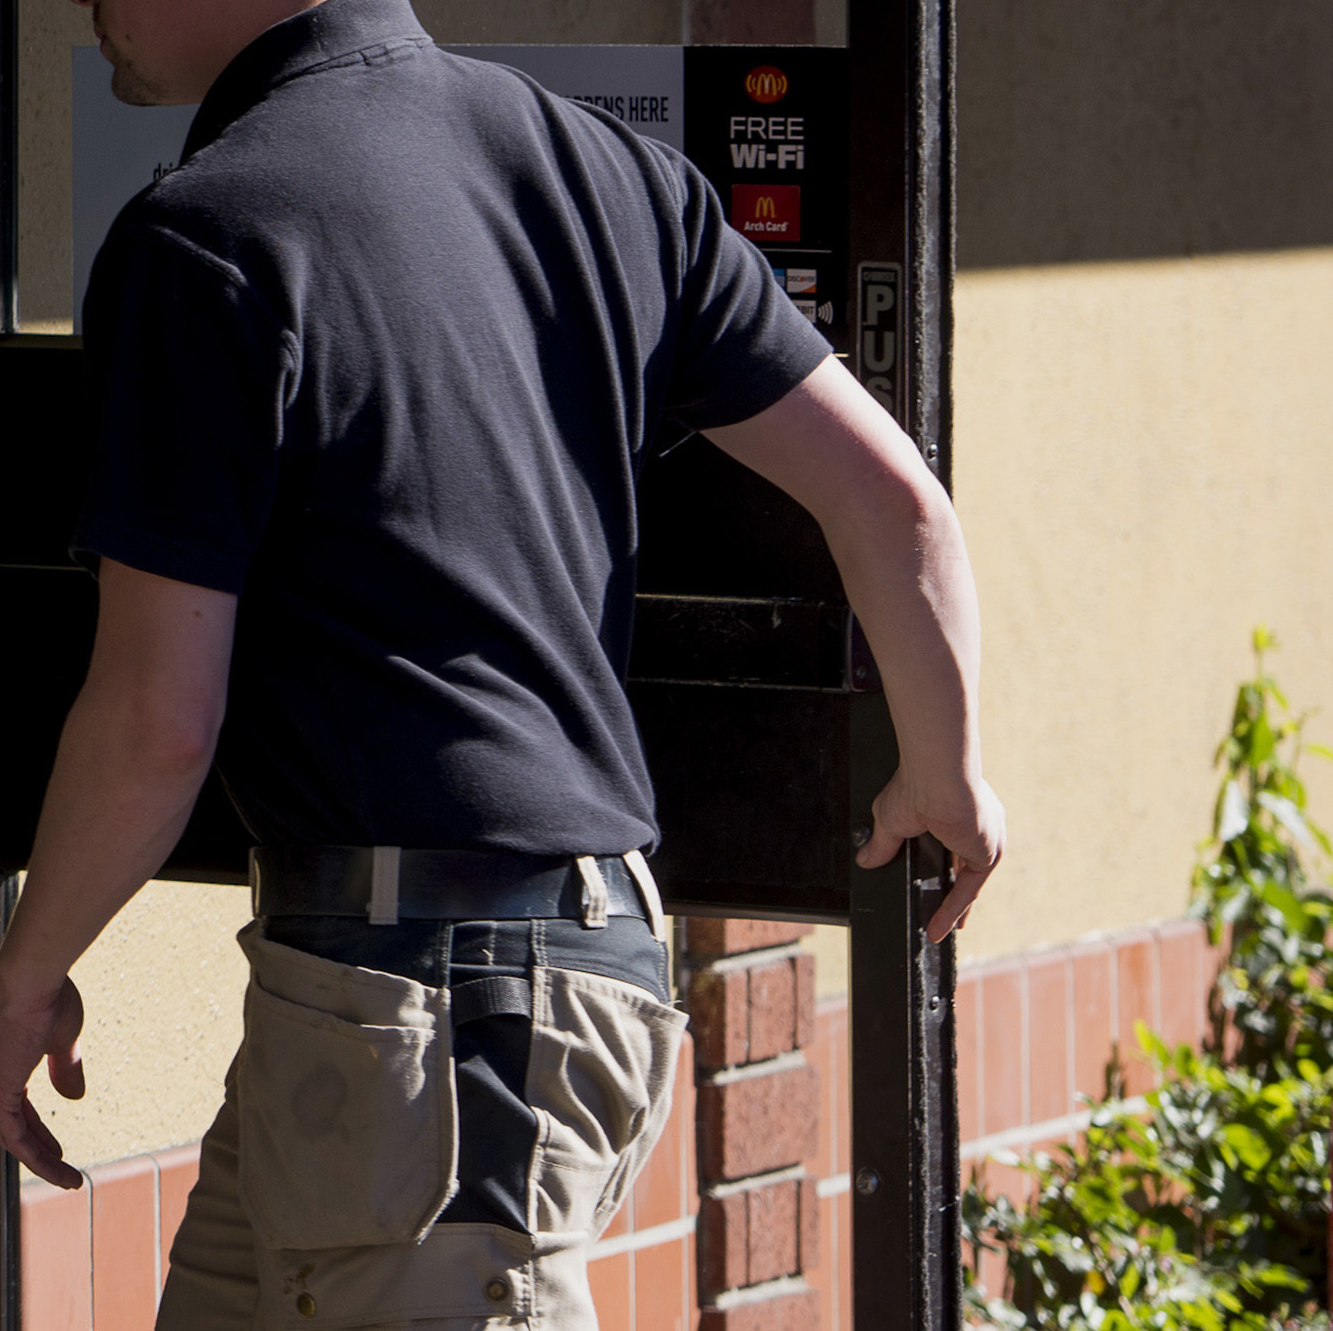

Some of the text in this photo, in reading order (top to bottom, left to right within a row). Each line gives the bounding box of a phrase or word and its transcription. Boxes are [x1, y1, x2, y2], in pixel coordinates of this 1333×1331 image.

[629, 96, 668, 122] HERE
[729, 116, 805, 140] FREE
[729, 143, 805, 170] Wi-Fi
[743, 221, 765, 232] Arch
[862, 284, 895, 413] PUS
